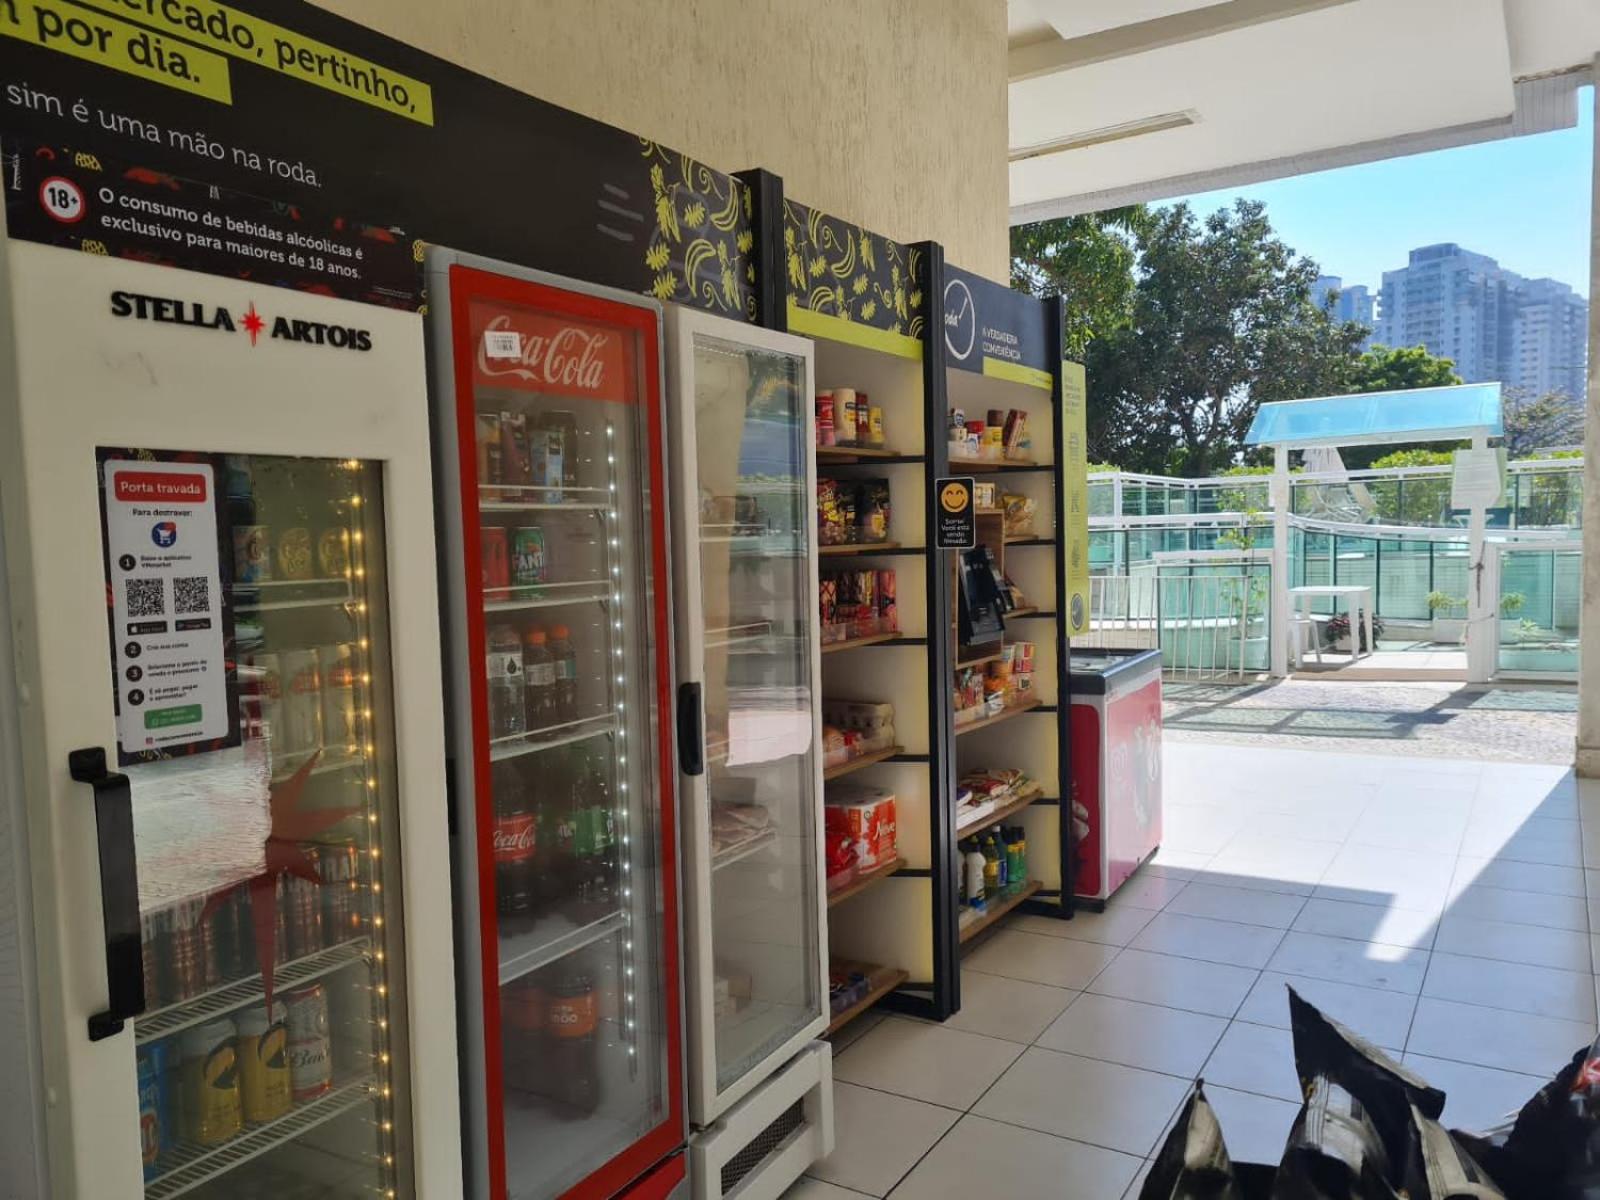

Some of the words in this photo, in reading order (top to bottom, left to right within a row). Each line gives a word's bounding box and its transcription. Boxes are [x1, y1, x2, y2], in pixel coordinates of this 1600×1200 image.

[33, 5, 112, 53] por
[128, 32, 200, 83] dia.
[110, 0, 264, 59] rcado,
[275, 37, 416, 113] pertinho,
[7, 82, 63, 117] sim
[72, 98, 89, 123] é
[99, 107, 161, 143] uma
[168, 126, 225, 161] mão
[232, 145, 261, 170] na
[268, 154, 322, 188] roda.
[47, 187, 79, 209] 18+
[99, 187, 114, 204] O
[119, 195, 198, 222] consumo
[203, 211, 222, 227] de
[226, 216, 283, 242] bebidas
[286, 232, 352, 258] alcóolicas
[355, 247, 364, 260] é
[101, 214, 182, 242] exclusivo
[186, 231, 221, 250] para
[226, 240, 285, 263] maiores
[288, 253, 305, 267] de
[308, 256, 324, 271] 18
[327, 263, 362, 279] anos.
[111, 291, 236, 332] STELLA
[271, 317, 372, 351] ARTOIS
[121, 481, 153, 493] Porta
[157, 483, 200, 495] travada
[132, 508, 151, 517] Para
[130, 645, 137, 655] 2
[133, 692, 140, 702] 4
